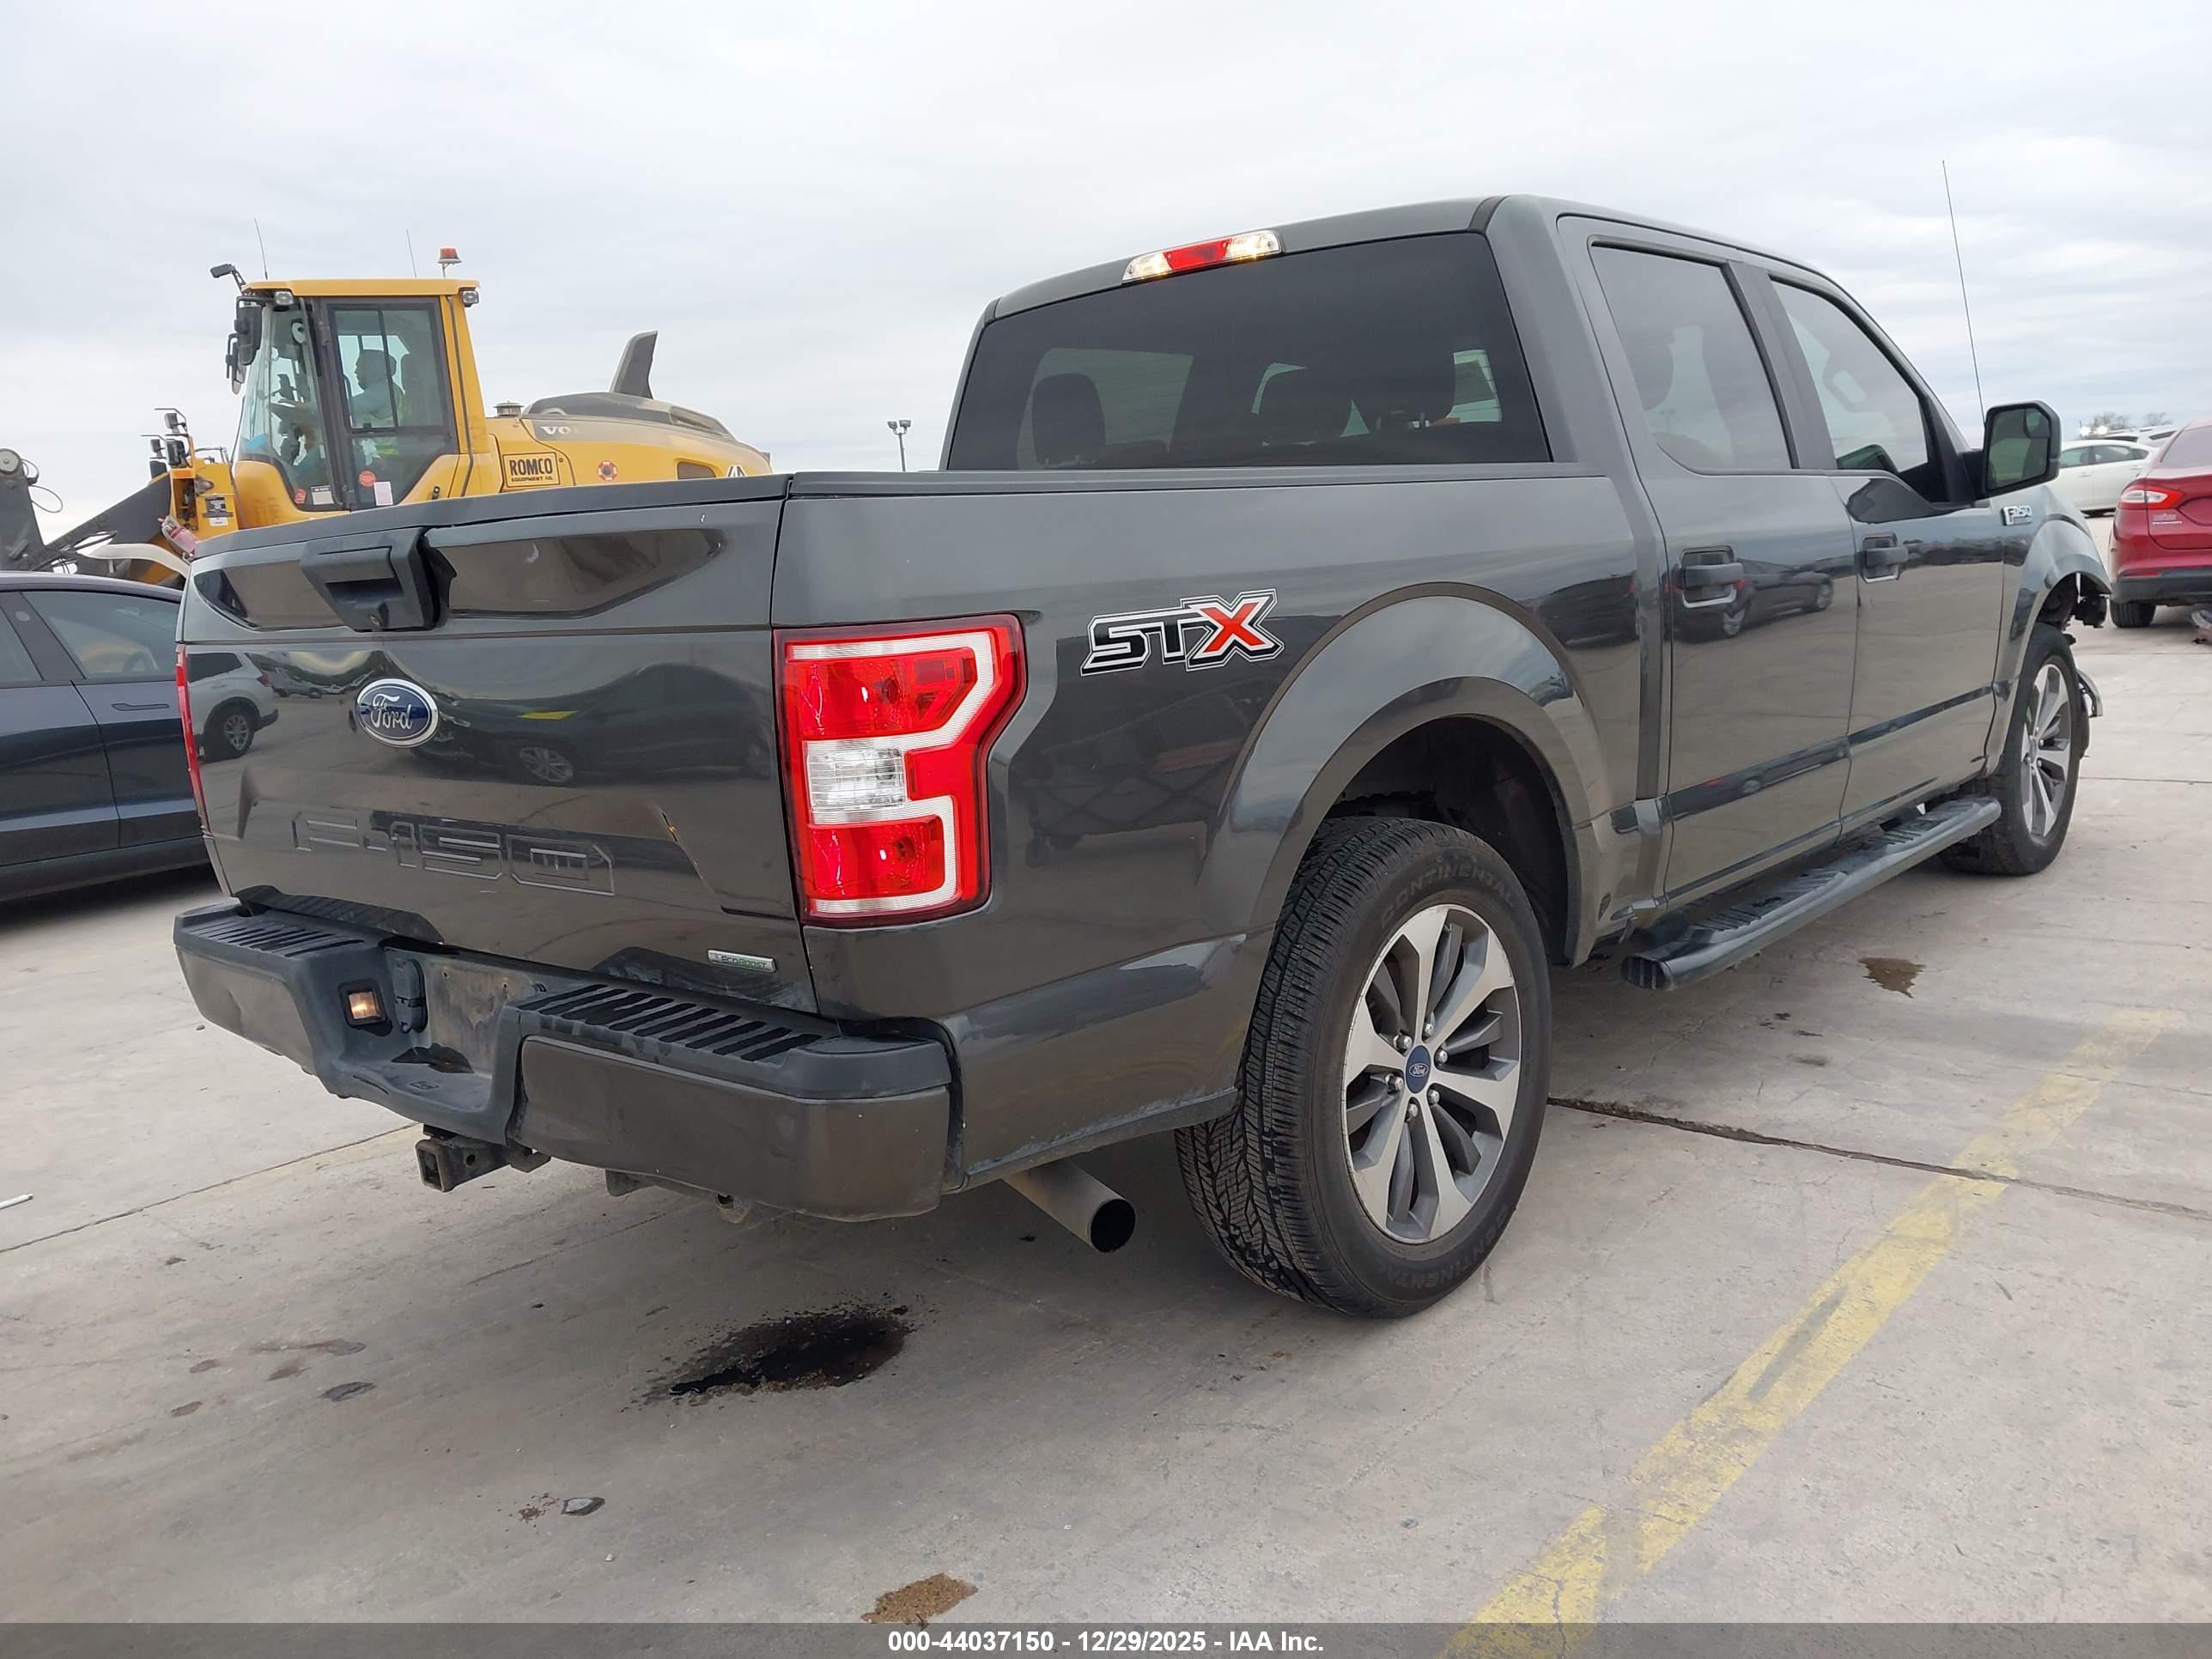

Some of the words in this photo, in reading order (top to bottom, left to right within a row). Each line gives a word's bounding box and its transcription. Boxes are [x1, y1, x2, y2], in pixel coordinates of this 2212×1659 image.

[508, 458, 553, 476] ROMCO
[1081, 589, 1283, 676] STX
[371, 692, 412, 729] Ford
[1381, 864, 1514, 929] CONTINENTAL
